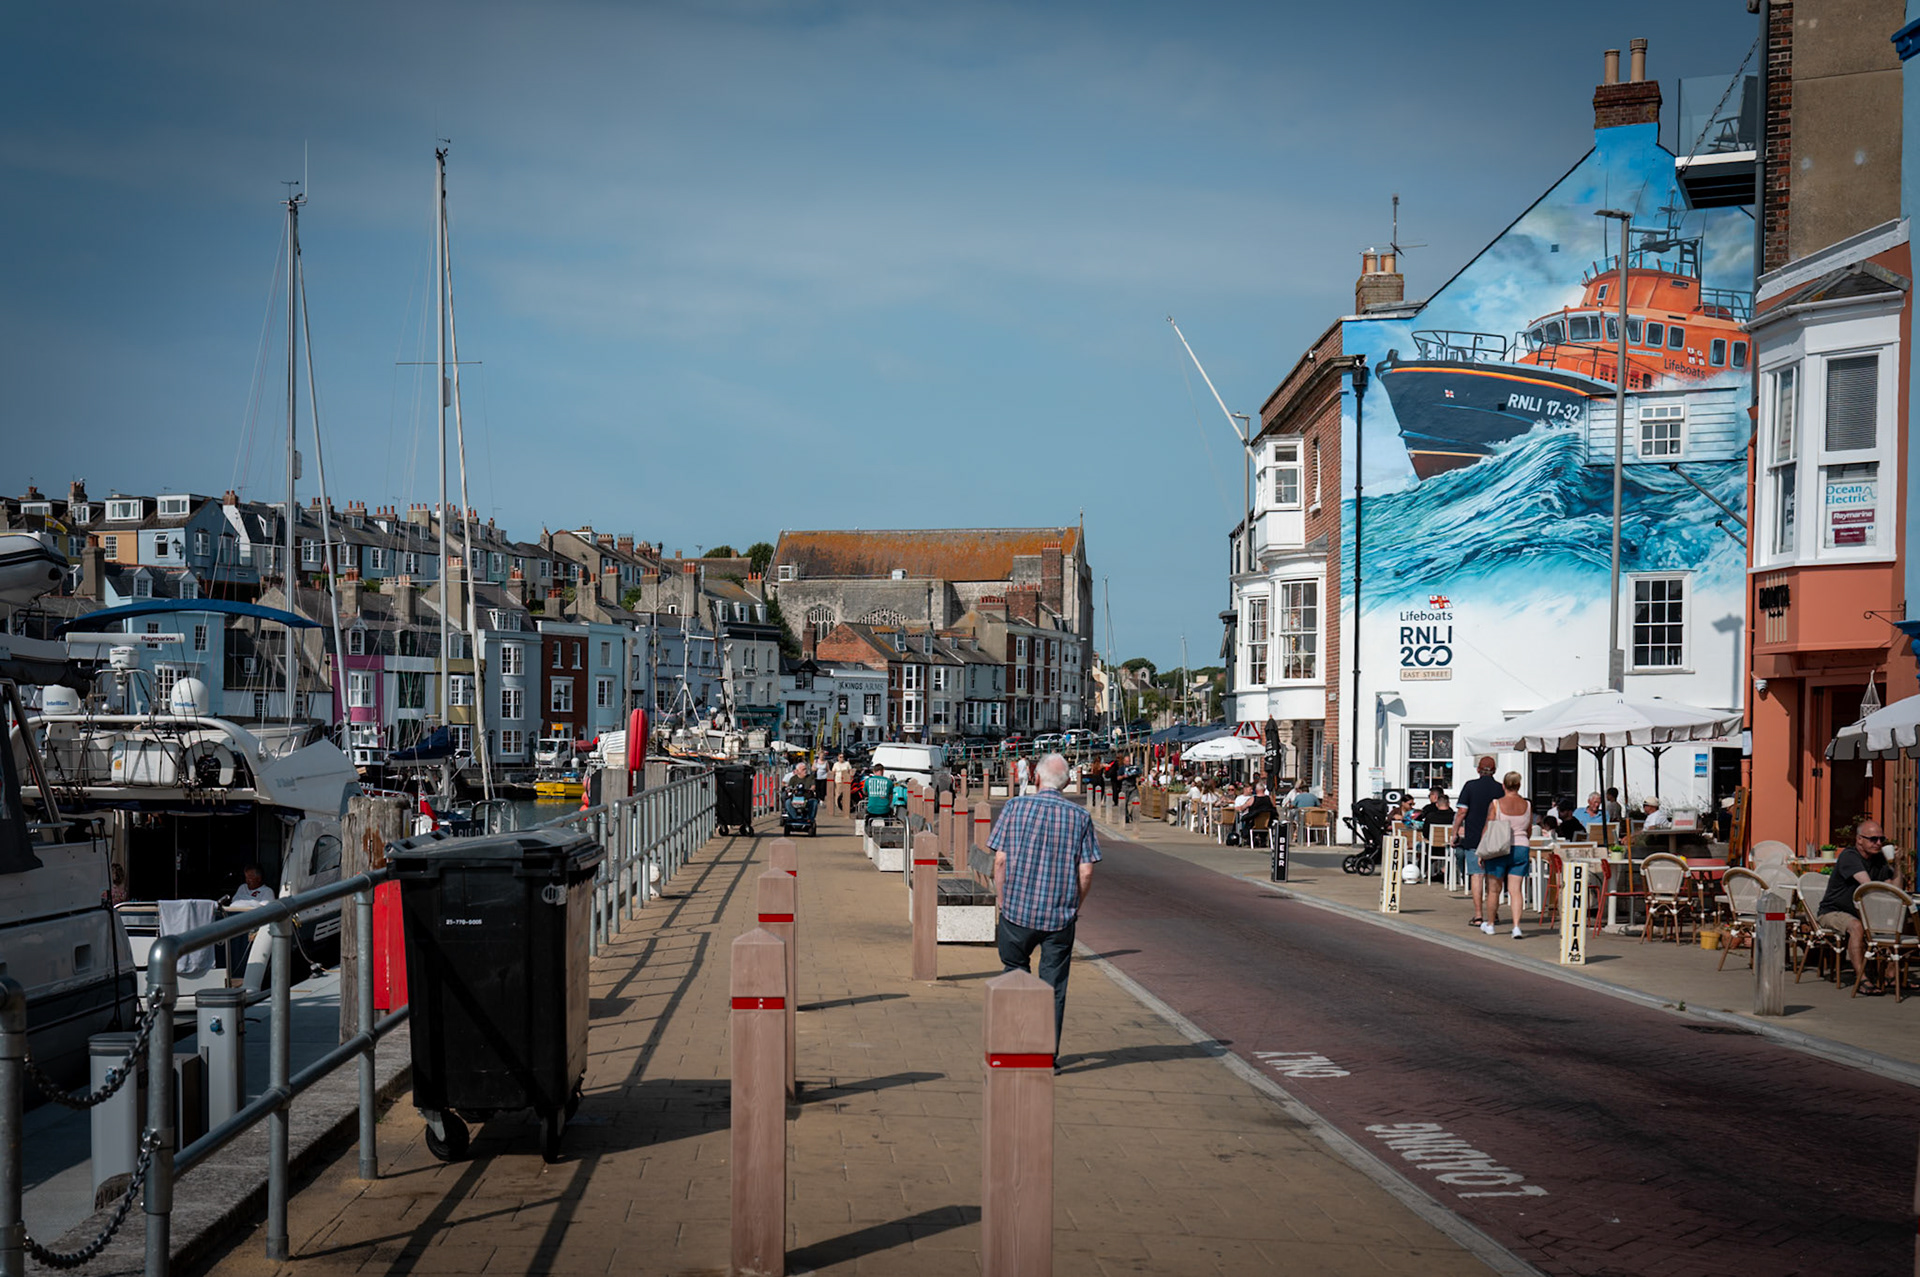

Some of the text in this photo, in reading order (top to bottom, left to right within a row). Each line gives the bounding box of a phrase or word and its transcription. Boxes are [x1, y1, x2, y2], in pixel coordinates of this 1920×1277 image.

[1663, 358, 1706, 379] Lifeboats
[1507, 393, 1581, 422] RNLI 17-32
[1826, 485, 1862, 495] Ocean
[1826, 493, 1868, 505] Electric
[1833, 511, 1873, 521] Raymarine
[1400, 610, 1453, 621] Lifeboats
[1400, 625, 1452, 645] RNLI
[1400, 645, 1453, 667] 200
[845, 682, 884, 690] KINGS ARMS
[1278, 837, 1286, 867] BEER
[1390, 838, 1401, 904] BONITA
[1570, 866, 1583, 952] BONITA
[1252, 1051, 1351, 1078] ONLY
[1364, 1122, 1550, 1199] LOADING
